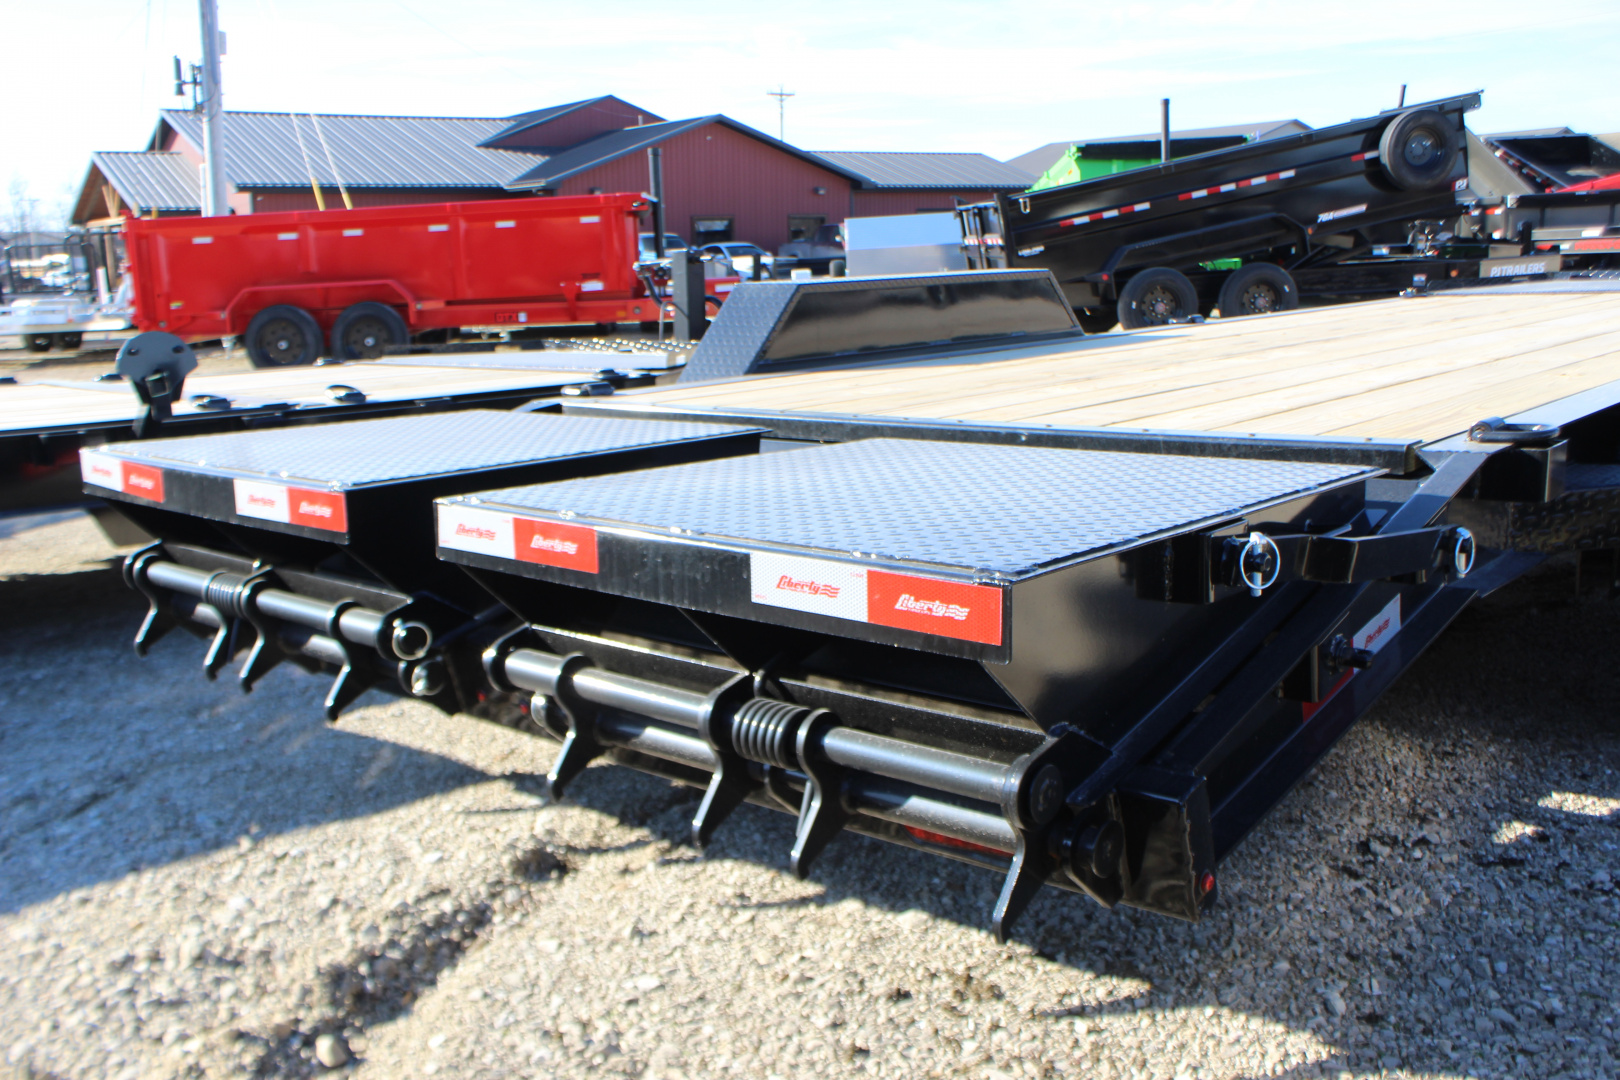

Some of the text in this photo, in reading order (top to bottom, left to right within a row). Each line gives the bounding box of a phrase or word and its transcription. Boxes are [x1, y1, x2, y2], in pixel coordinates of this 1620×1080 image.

[1490, 263, 1546, 278] PJ TRAILERS
[456, 524, 486, 539] Liberty
[530, 534, 565, 553] Liberty
[776, 574, 822, 595] Liberty
[894, 594, 948, 616] Liberty
